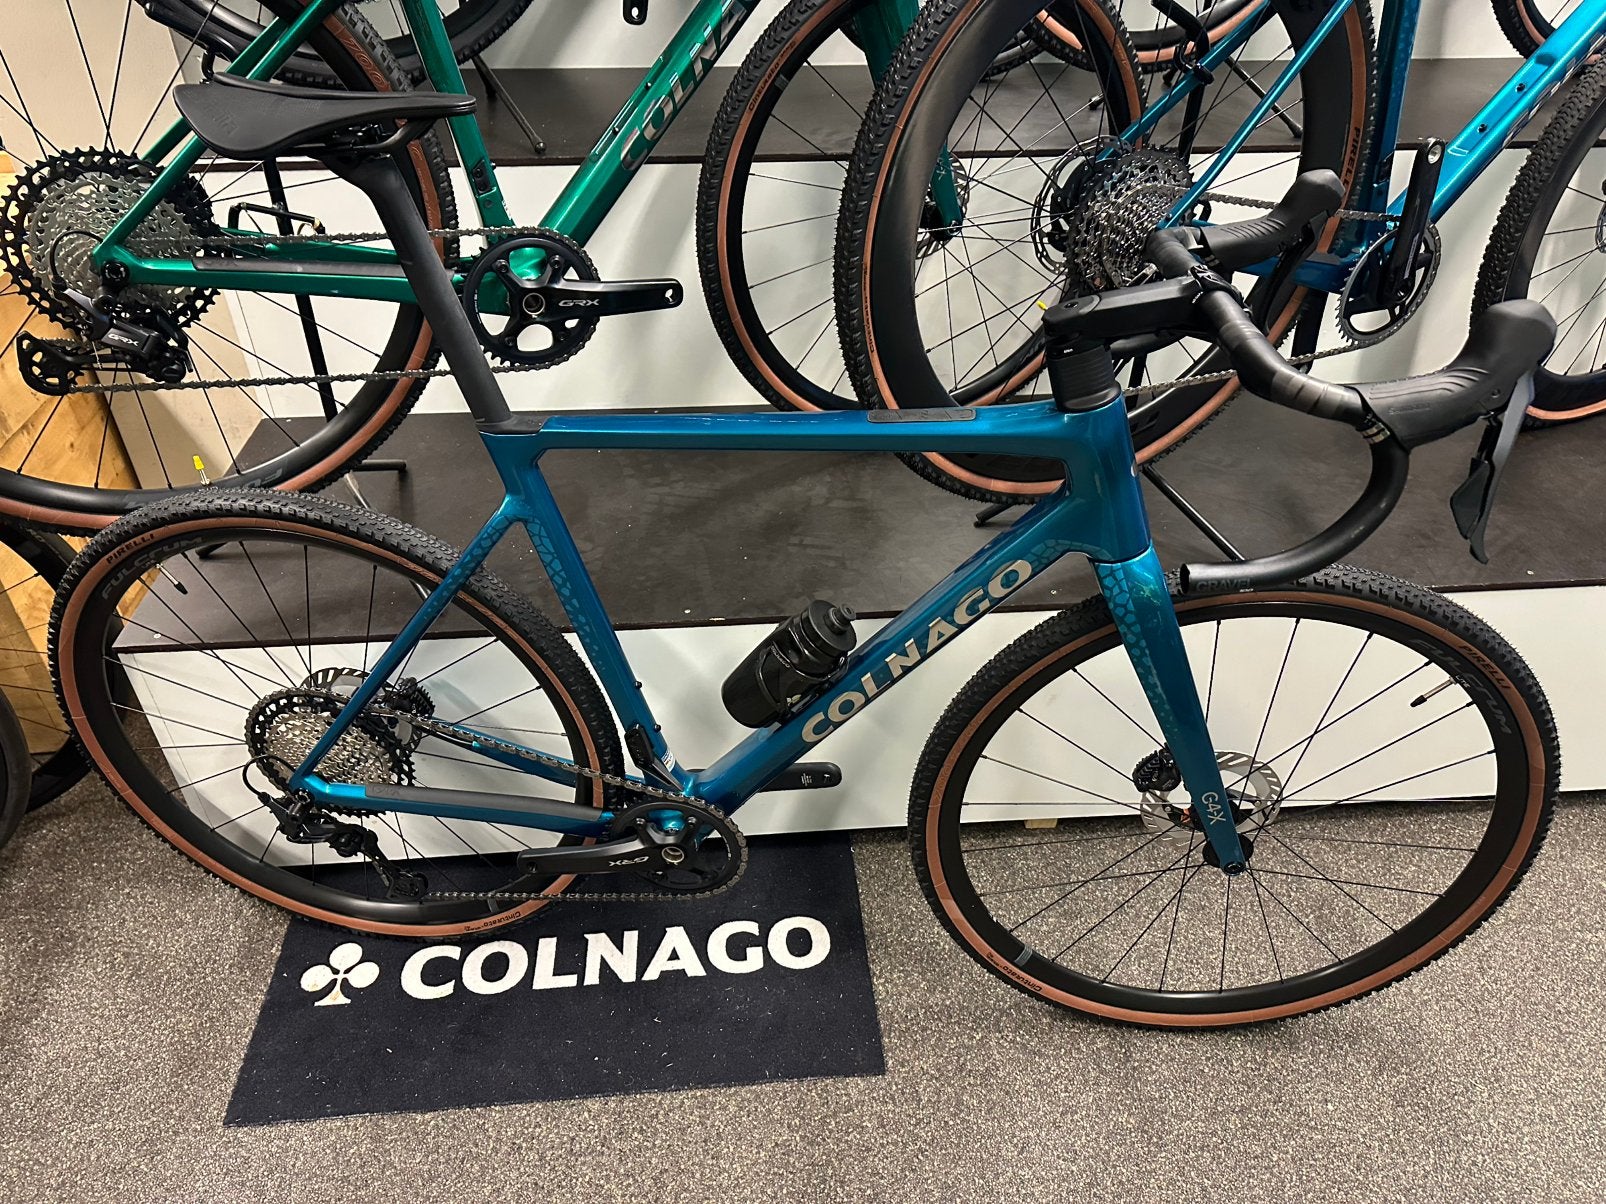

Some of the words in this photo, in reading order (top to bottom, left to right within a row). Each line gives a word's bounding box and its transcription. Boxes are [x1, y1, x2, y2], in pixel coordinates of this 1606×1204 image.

[1342, 127, 1360, 188] PIRELL
[558, 298, 600, 307] GRX
[107, 333, 139, 347] GRX
[106, 533, 155, 565] PIRELLI
[801, 559, 1032, 743] COLNAGO
[1459, 644, 1511, 690] PIRELLI
[608, 855, 650, 867] GRX
[483, 910, 522, 928] Cinturato
[400, 915, 832, 1000] COLNAGO
